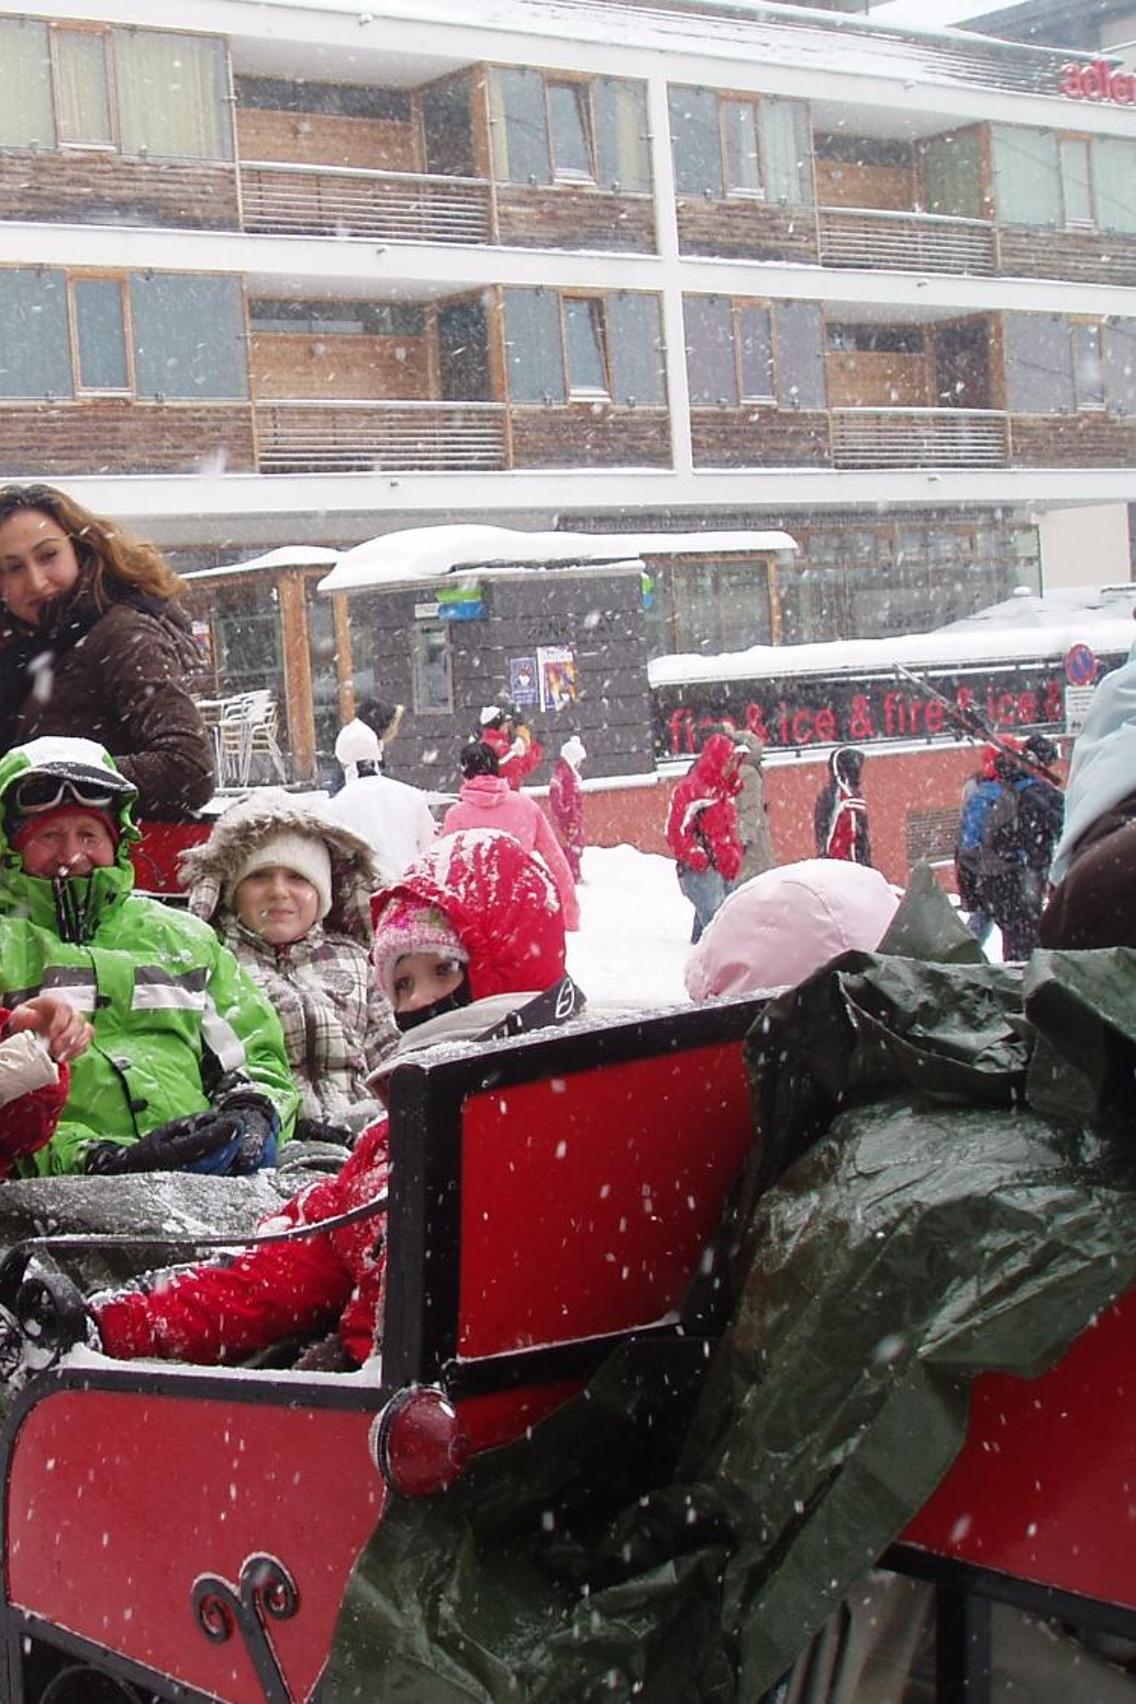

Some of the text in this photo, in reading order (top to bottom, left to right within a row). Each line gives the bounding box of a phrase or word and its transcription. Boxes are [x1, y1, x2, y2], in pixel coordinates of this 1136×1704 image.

[778, 700, 837, 743] ice
[848, 692, 876, 738] &
[884, 689, 945, 737] fire
[986, 684, 1037, 727] ice
